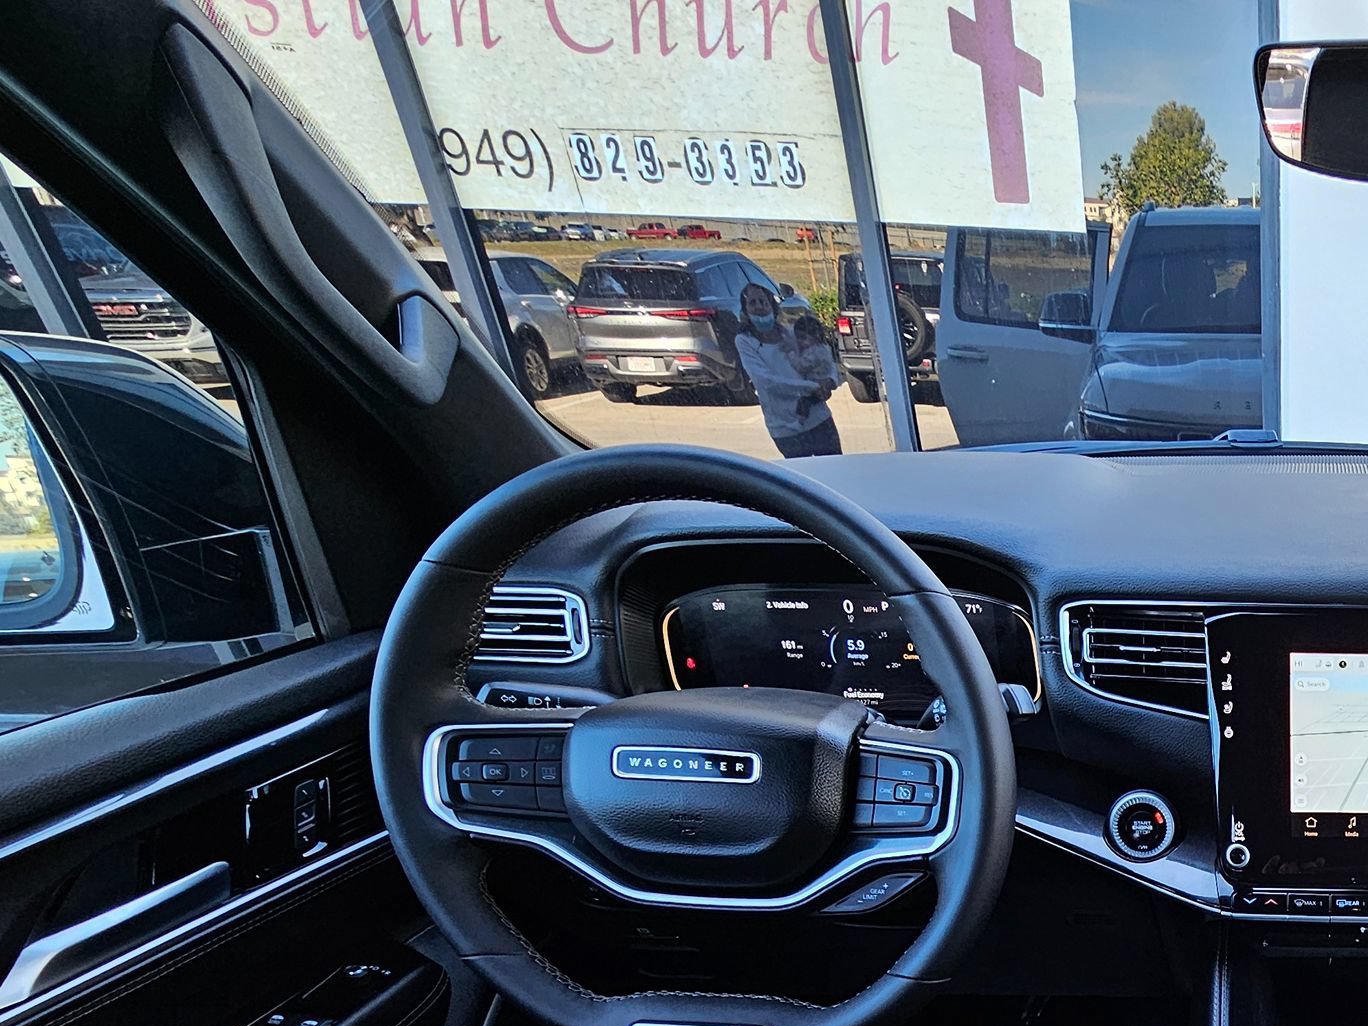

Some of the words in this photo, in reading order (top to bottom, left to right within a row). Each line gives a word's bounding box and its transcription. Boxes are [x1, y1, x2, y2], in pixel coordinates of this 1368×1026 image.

[862, 605, 878, 613] MPH
[847, 639, 865, 651] 5.9
[1307, 680, 1326, 688] Search
[629, 757, 745, 772] WAGONEER
